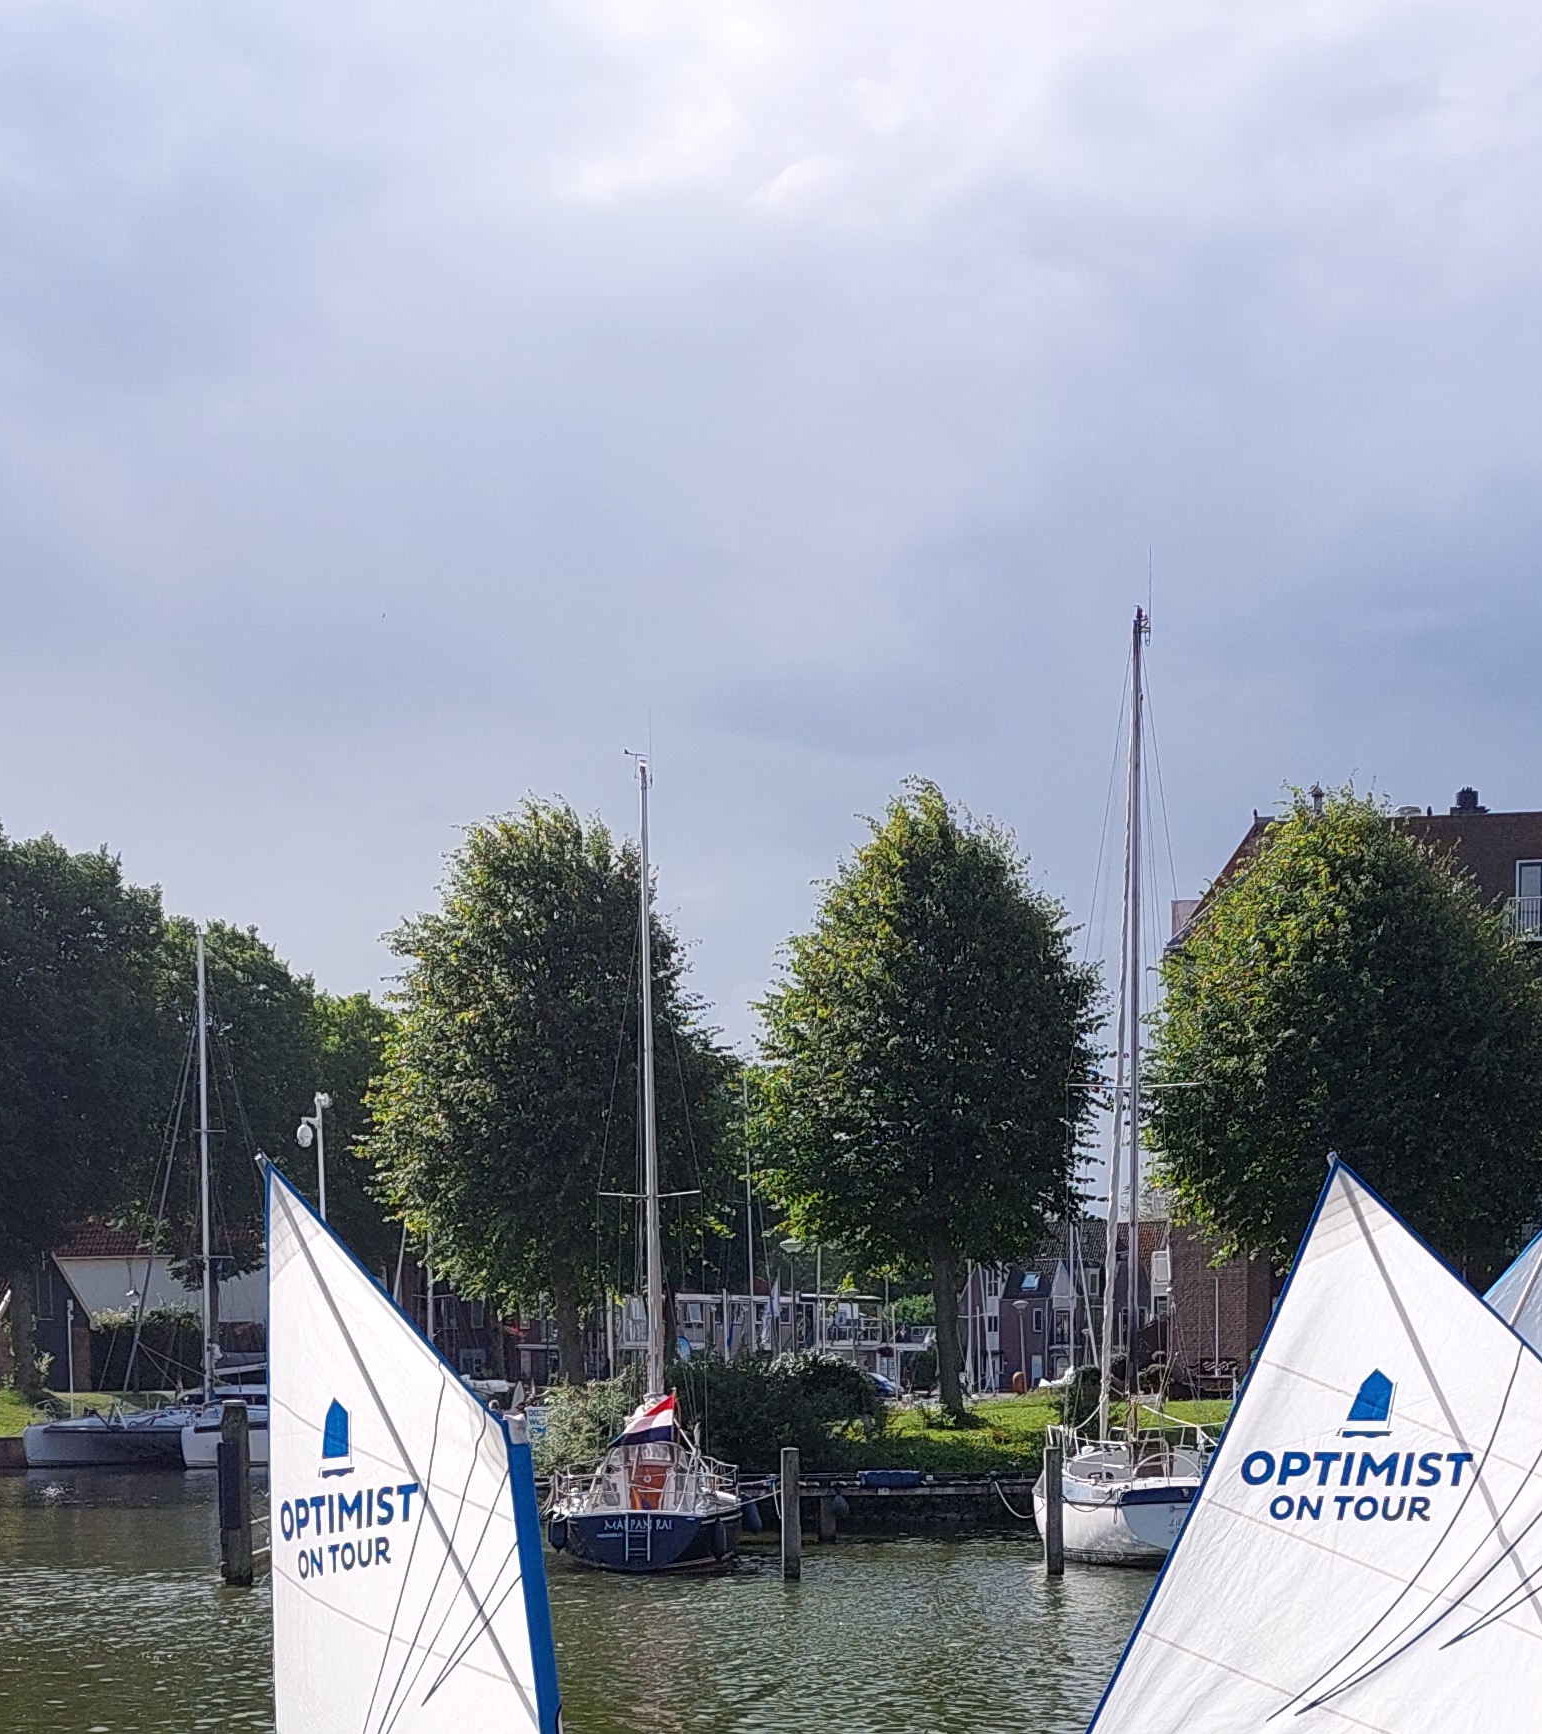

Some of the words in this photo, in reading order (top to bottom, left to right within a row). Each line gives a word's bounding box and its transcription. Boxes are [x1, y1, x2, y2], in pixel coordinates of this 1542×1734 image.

[1241, 1450, 1473, 1487] OPTIMIST
[280, 1482, 419, 1542] OPTIMIST
[1269, 1495, 1324, 1520] ON
[1333, 1496, 1431, 1521] TOUR
[297, 1546, 324, 1580] ON
[327, 1536, 392, 1572] TOUR
